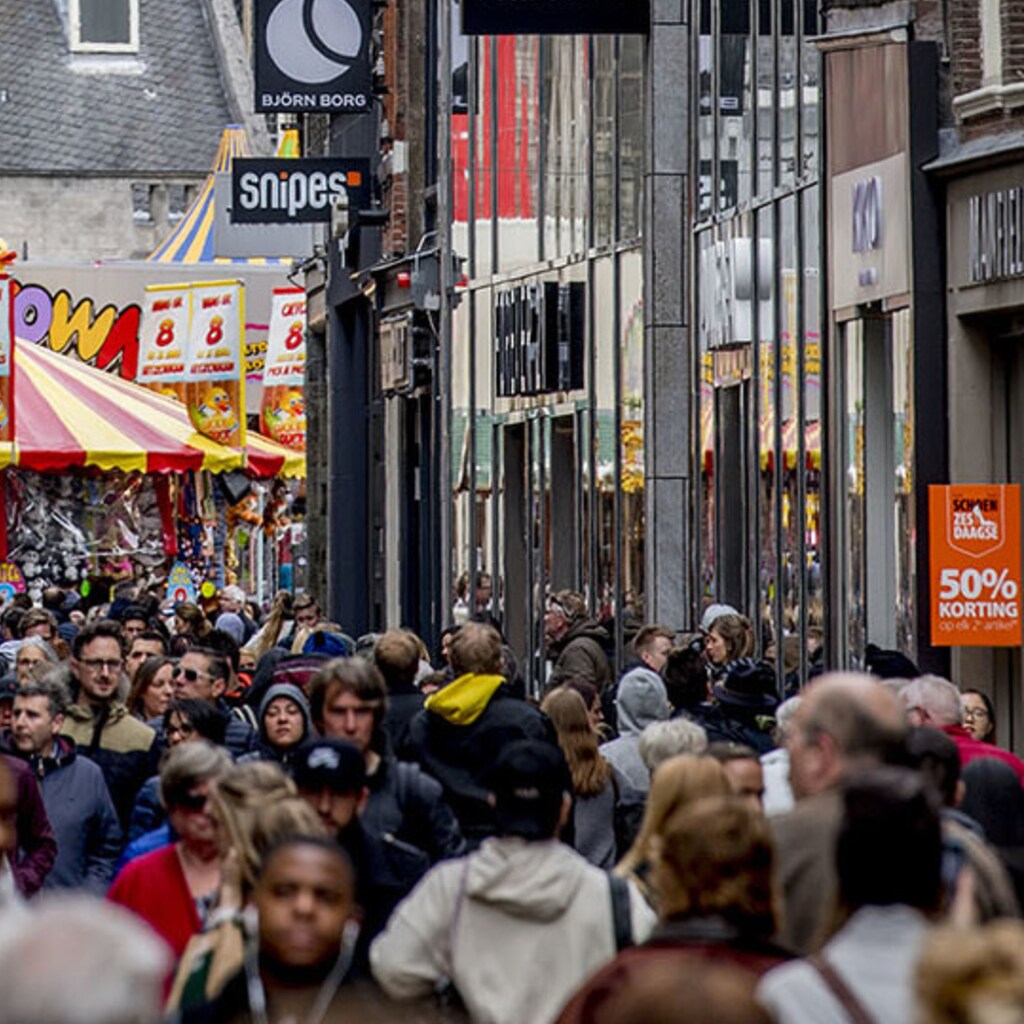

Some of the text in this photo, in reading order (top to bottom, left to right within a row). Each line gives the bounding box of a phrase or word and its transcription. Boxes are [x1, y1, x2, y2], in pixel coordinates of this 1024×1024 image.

[262, 92, 366, 106] BJÖRN BORG
[239, 171, 347, 217] snipes
[14, 283, 140, 381] OWN
[156, 318, 175, 348] 8
[205, 315, 224, 346] 8
[285, 320, 304, 351] 8
[953, 513, 974, 526] ZES
[953, 526, 999, 540] DAAGSE
[939, 567, 1018, 600] 50%
[939, 601, 1018, 618] KORTING
